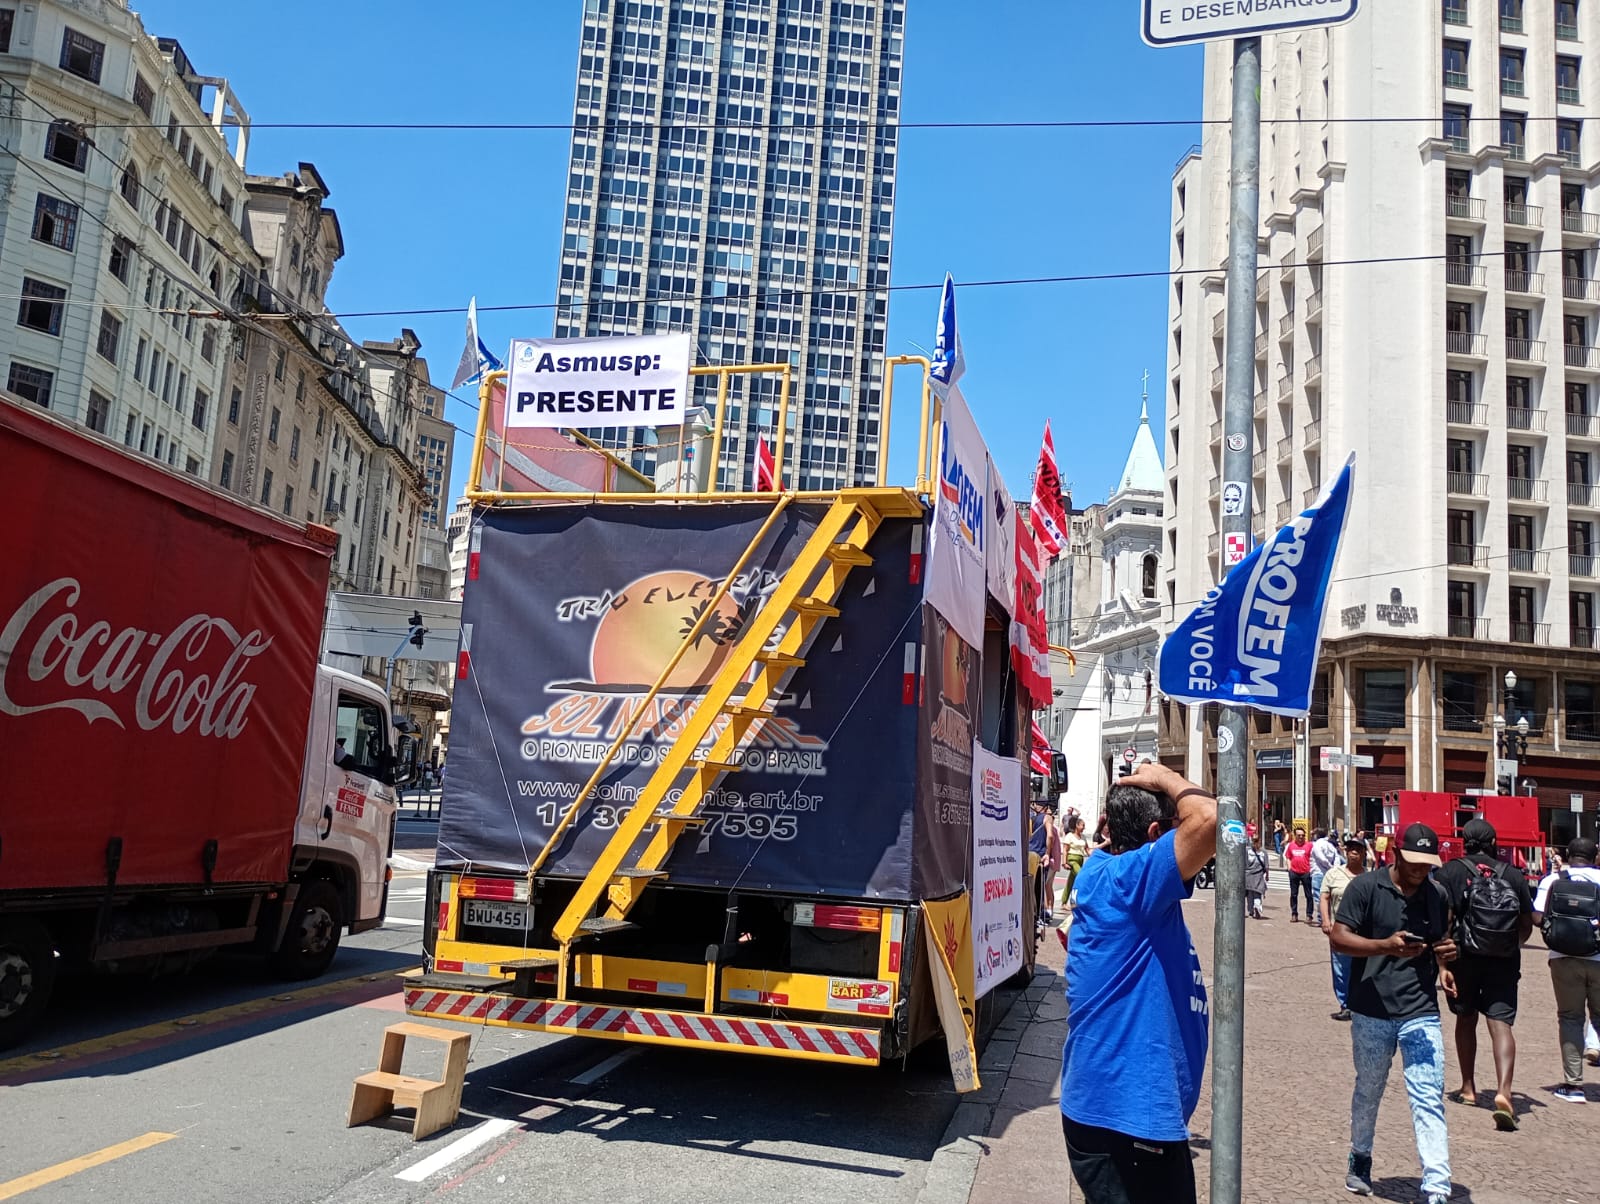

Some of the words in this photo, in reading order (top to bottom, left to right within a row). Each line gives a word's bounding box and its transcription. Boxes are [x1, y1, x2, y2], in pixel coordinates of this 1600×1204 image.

[1159, 10, 1172, 25] E
[1182, 0, 1343, 21] DESEMBAR
[535, 353, 661, 376] Asmusp:
[516, 388, 676, 413] PRESENTE
[559, 591, 629, 619] TRIO
[643, 569, 781, 604] ELETRIC
[1194, 575, 1228, 620] OM
[1233, 516, 1313, 698] PROFEM
[0, 577, 275, 739] Coca-Cola
[1188, 625, 1217, 693] VOCÊ
[523, 694, 604, 734] SOL
[523, 741, 538, 757] O
[542, 742, 620, 762] PIONEIRO
[627, 745, 654, 763] DO
[733, 750, 761, 767] DO
[767, 749, 823, 770] BRASIL
[517, 780, 824, 812] www.solncnte.art.br
[536, 801, 580, 828] 11
[832, 986, 864, 998] BARI
